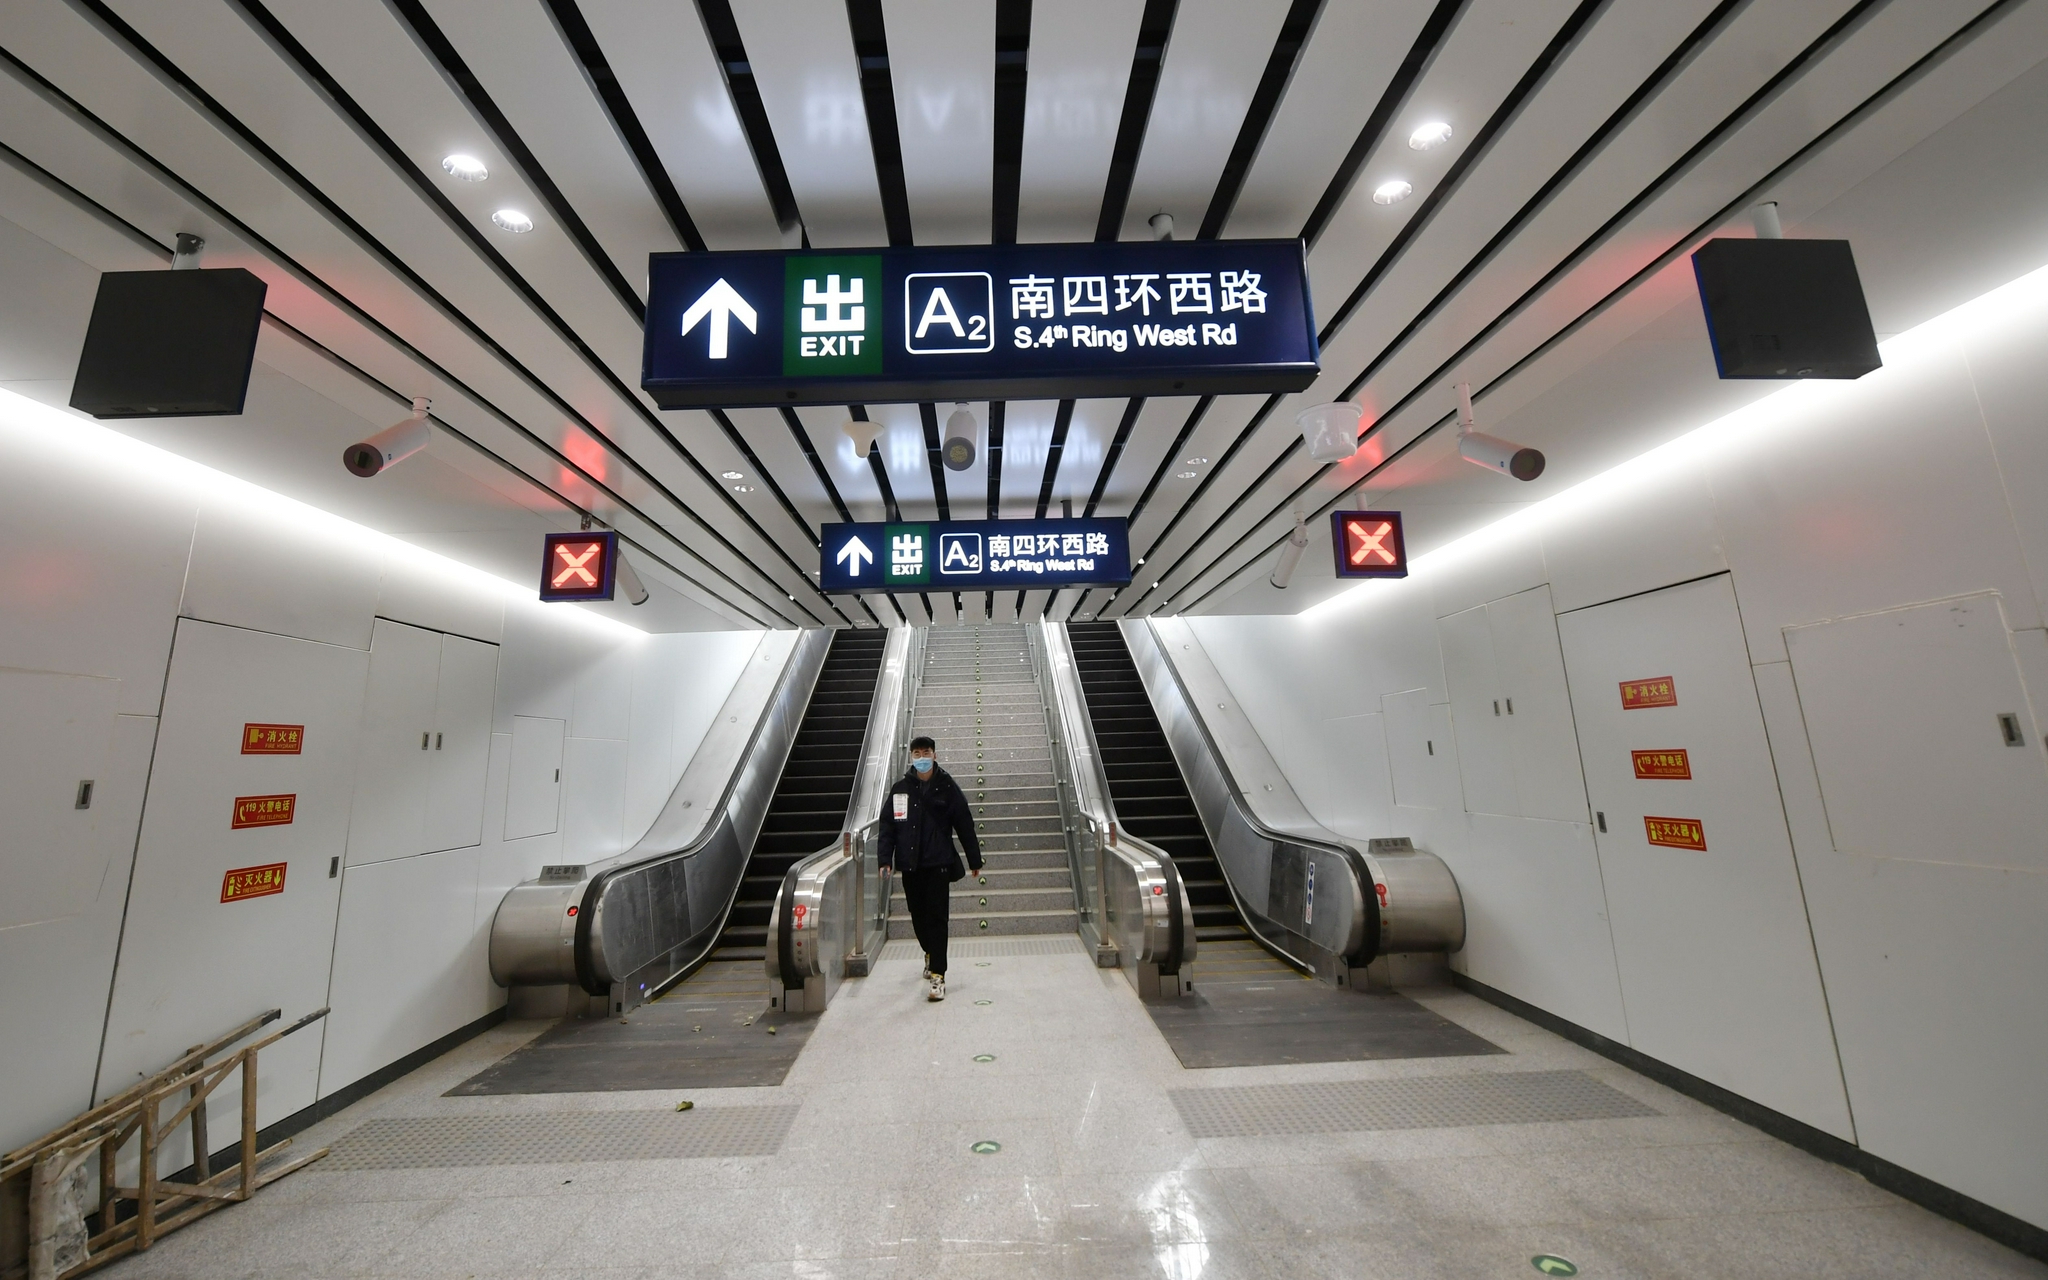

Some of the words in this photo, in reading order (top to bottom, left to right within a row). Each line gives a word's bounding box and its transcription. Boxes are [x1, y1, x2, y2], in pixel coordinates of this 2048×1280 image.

[802, 274, 866, 332] 出
[1008, 269, 1268, 320] 南四环西路
[915, 287, 986, 341] A2
[801, 336, 864, 358] EXIT
[1014, 324, 1068, 350] S.4th
[1072, 326, 1128, 353] Ring
[1132, 324, 1197, 348] West
[1202, 323, 1237, 347] Rd
[891, 533, 923, 563] 出
[945, 540, 979, 568] A2
[988, 532, 1109, 557] 南四环西路
[892, 564, 922, 576] EXIT
[1017, 560, 1044, 574] Ring
[1046, 557, 1076, 571] West
[1077, 558, 1094, 571] Rd
[1639, 683, 1669, 697] 消火栓
[266, 730, 298, 743] 消火栓
[1652, 754, 1683, 767] 火警电话
[245, 802, 257, 813] 119
[258, 800, 290, 813] 火警电话
[1662, 823, 1690, 837] 灭火器
[244, 870, 273, 887] 灭火器
